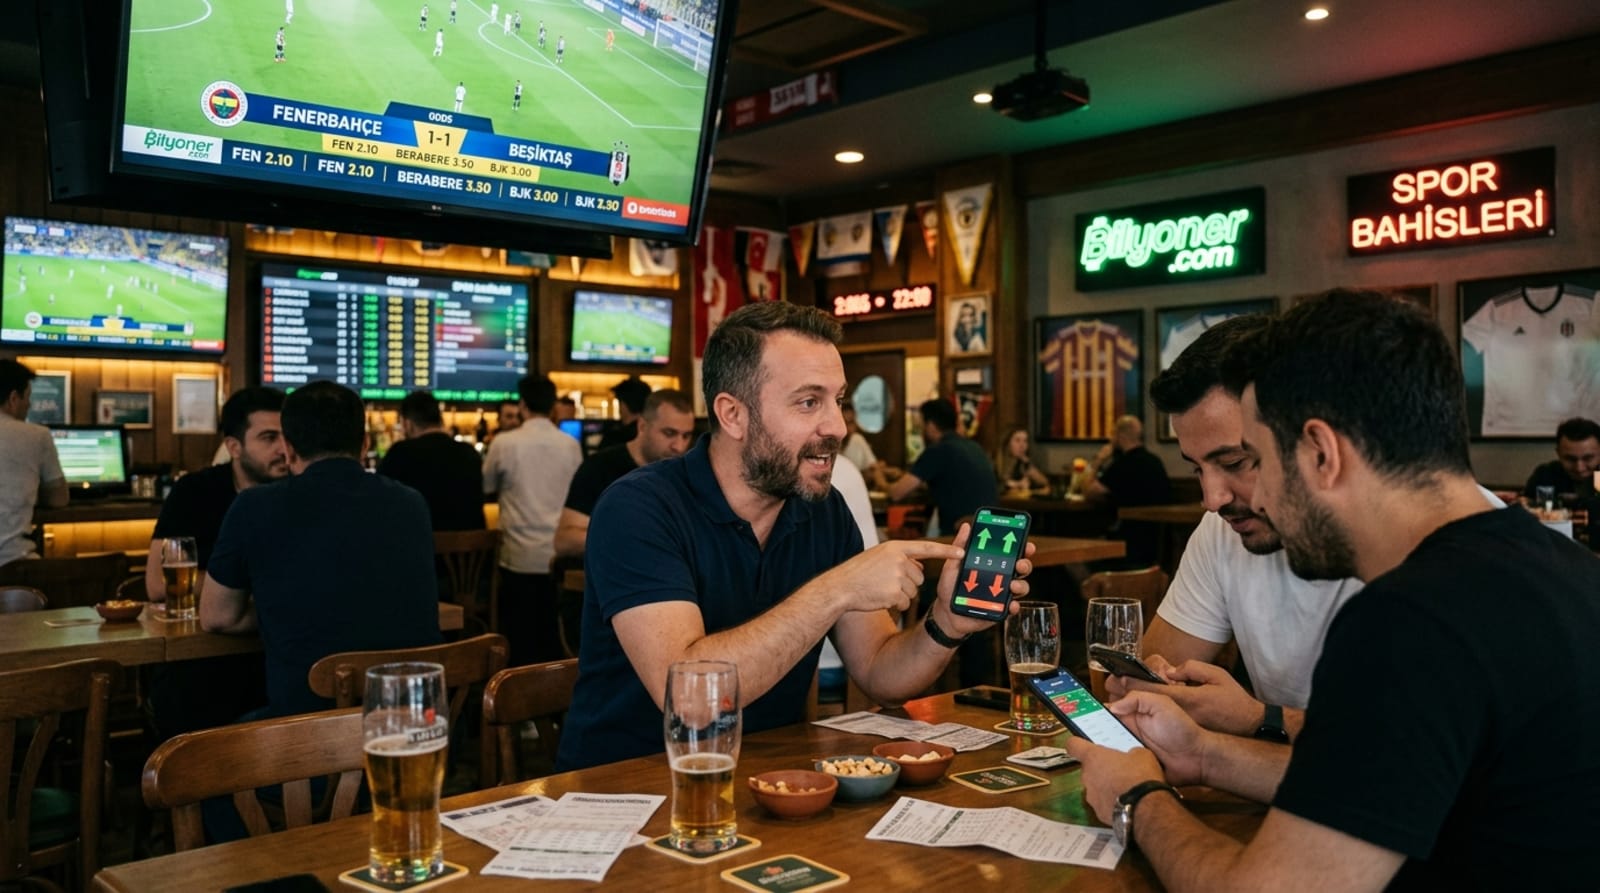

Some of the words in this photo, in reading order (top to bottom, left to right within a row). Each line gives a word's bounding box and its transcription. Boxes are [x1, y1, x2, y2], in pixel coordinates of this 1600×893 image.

[272, 104, 383, 136] FENERBAHÇE
[428, 130, 450, 146] 1-1
[332, 139, 354, 151] FEN
[356, 143, 379, 155] 2.10
[395, 148, 450, 166] BERABERE
[452, 158, 474, 169] 3.50
[490, 163, 508, 174] BJK
[511, 167, 532, 178] 3.00
[508, 143, 573, 168] BEŞİKTAŞ
[232, 147, 262, 163] FEN
[264, 152, 293, 167] 2.10
[317, 159, 345, 174] FEN
[347, 163, 374, 178] 2.10
[397, 170, 463, 190] BERABERE
[509, 186, 532, 200] BJK
[533, 189, 559, 203] 3.00
[575, 195, 596, 209] BJK
[1392, 161, 1498, 204] SPOR
[1352, 190, 1545, 249] BAHİSLERİ
[1080, 208, 1250, 272] Bilyoner
[1168, 245, 1234, 273] .com
